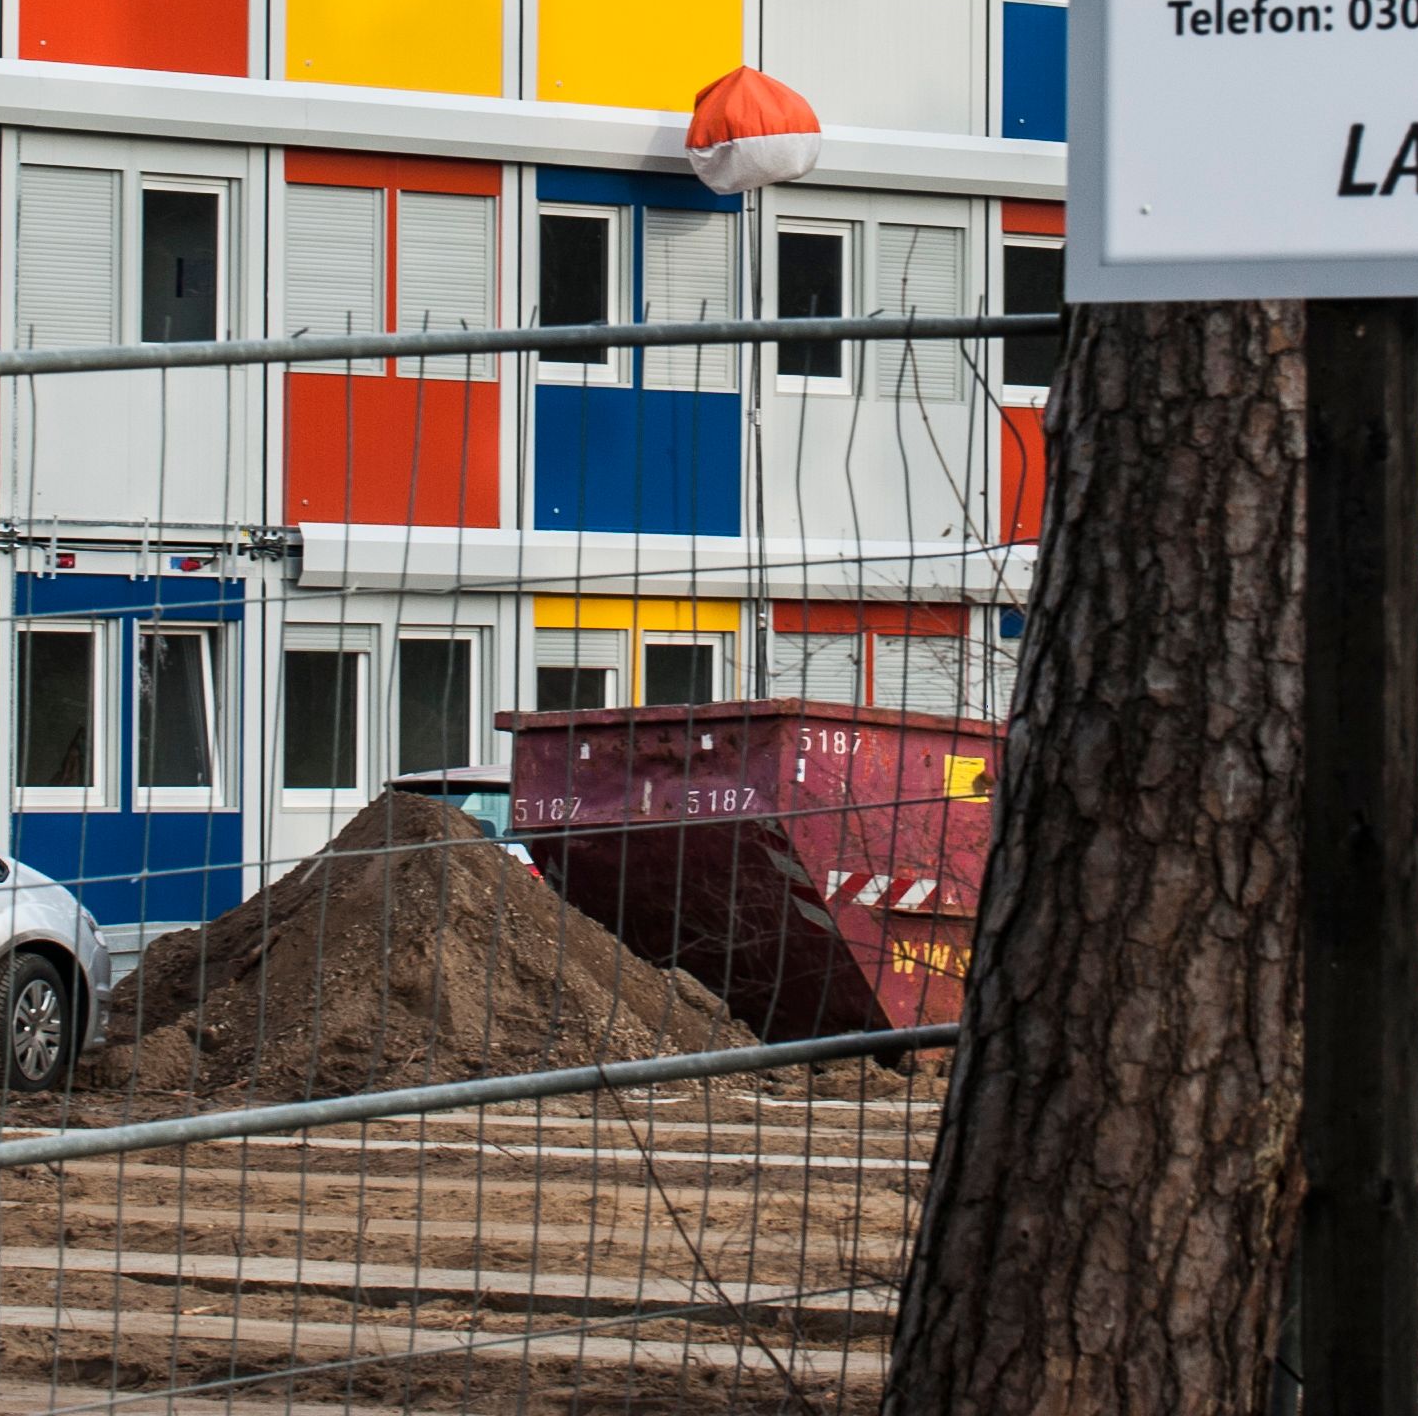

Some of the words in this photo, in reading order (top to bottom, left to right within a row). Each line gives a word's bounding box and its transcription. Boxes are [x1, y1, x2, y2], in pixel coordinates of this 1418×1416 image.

[800, 727, 863, 756] 5187
[514, 796, 583, 823] 5187
[686, 787, 757, 815] 5187
